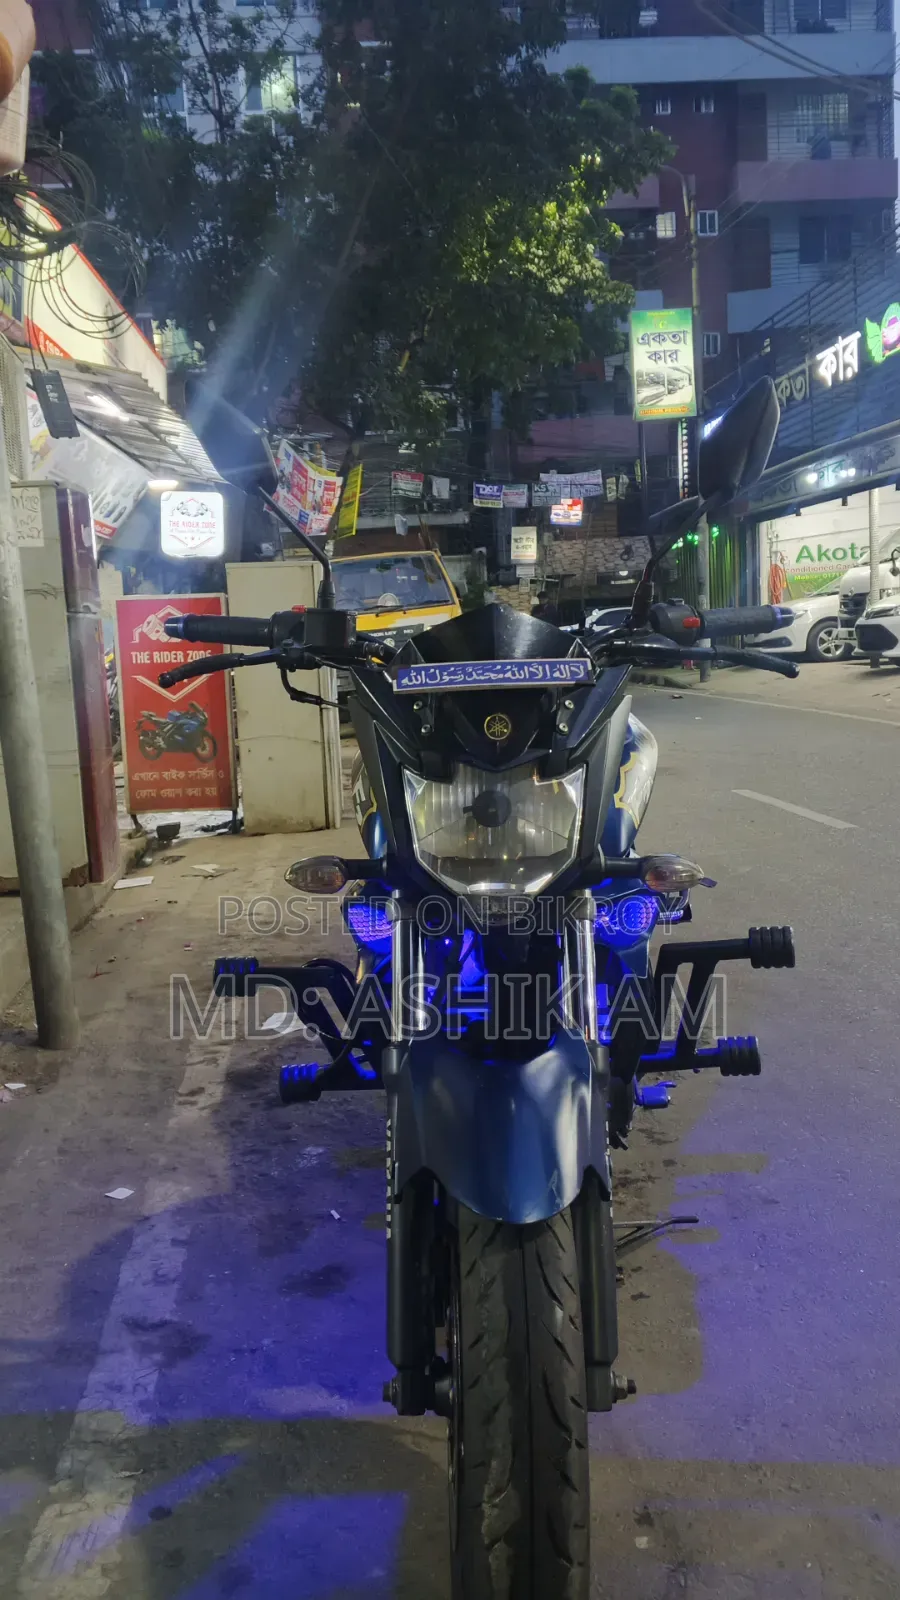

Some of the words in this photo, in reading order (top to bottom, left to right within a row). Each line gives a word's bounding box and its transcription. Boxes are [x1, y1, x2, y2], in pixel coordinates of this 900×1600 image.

[637, 329, 690, 348] একতা
[645, 349, 682, 365] কার
[774, 353, 813, 408] কতা
[816, 330, 861, 387] কার
[131, 651, 151, 665] THE
[153, 650, 184, 664] RIDER
[186, 649, 212, 663] ZONE
[161, 768, 185, 781] বাইক
